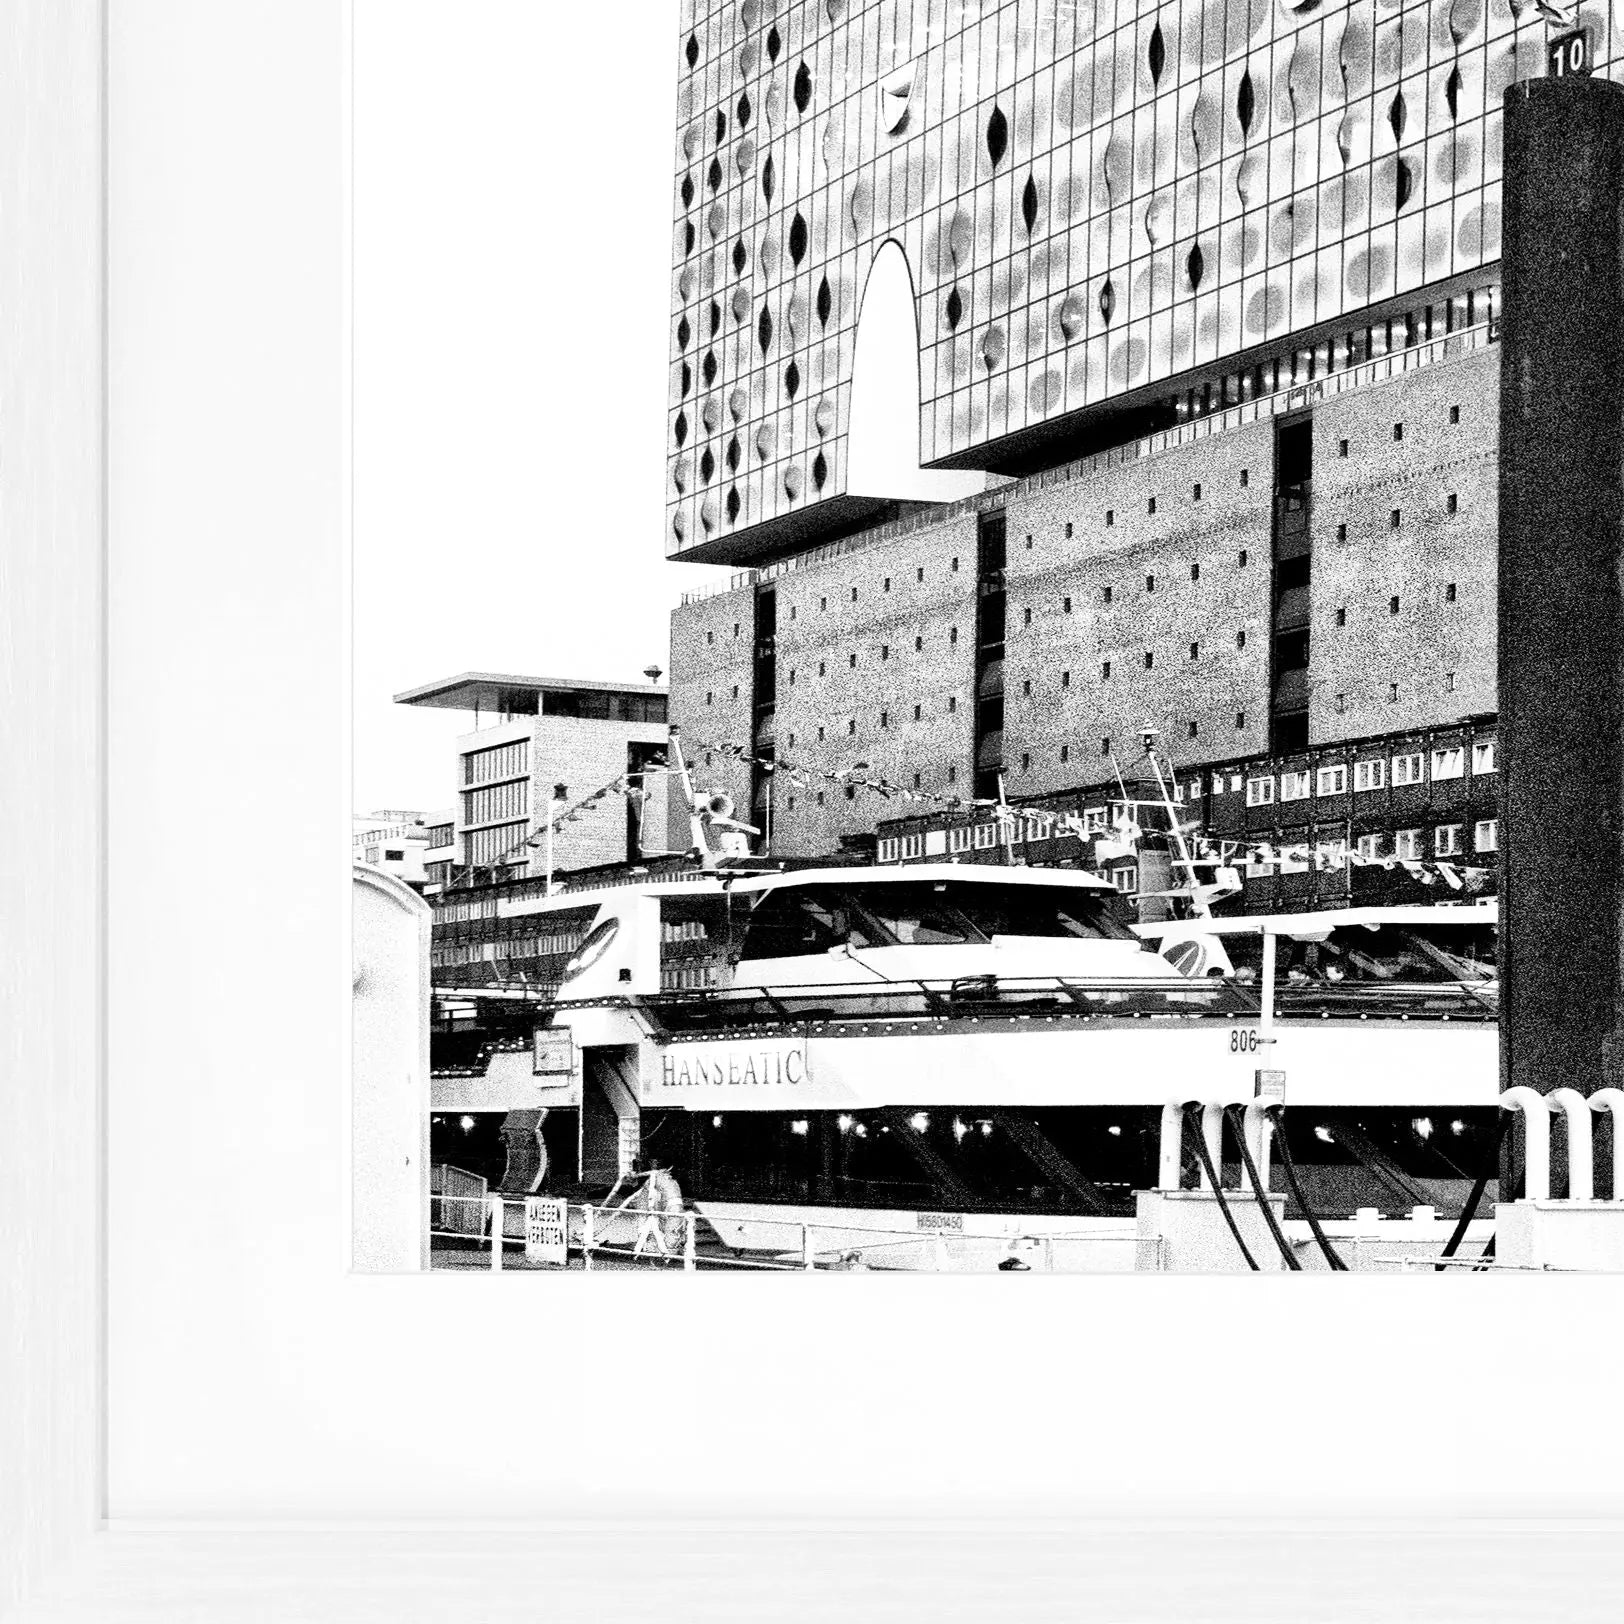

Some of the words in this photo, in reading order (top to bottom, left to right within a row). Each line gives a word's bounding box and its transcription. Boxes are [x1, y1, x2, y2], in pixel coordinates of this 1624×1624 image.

[1553, 38, 1583, 77] 10
[1230, 1029, 1257, 1053] 806
[661, 1050, 802, 1087] HANSEATIC
